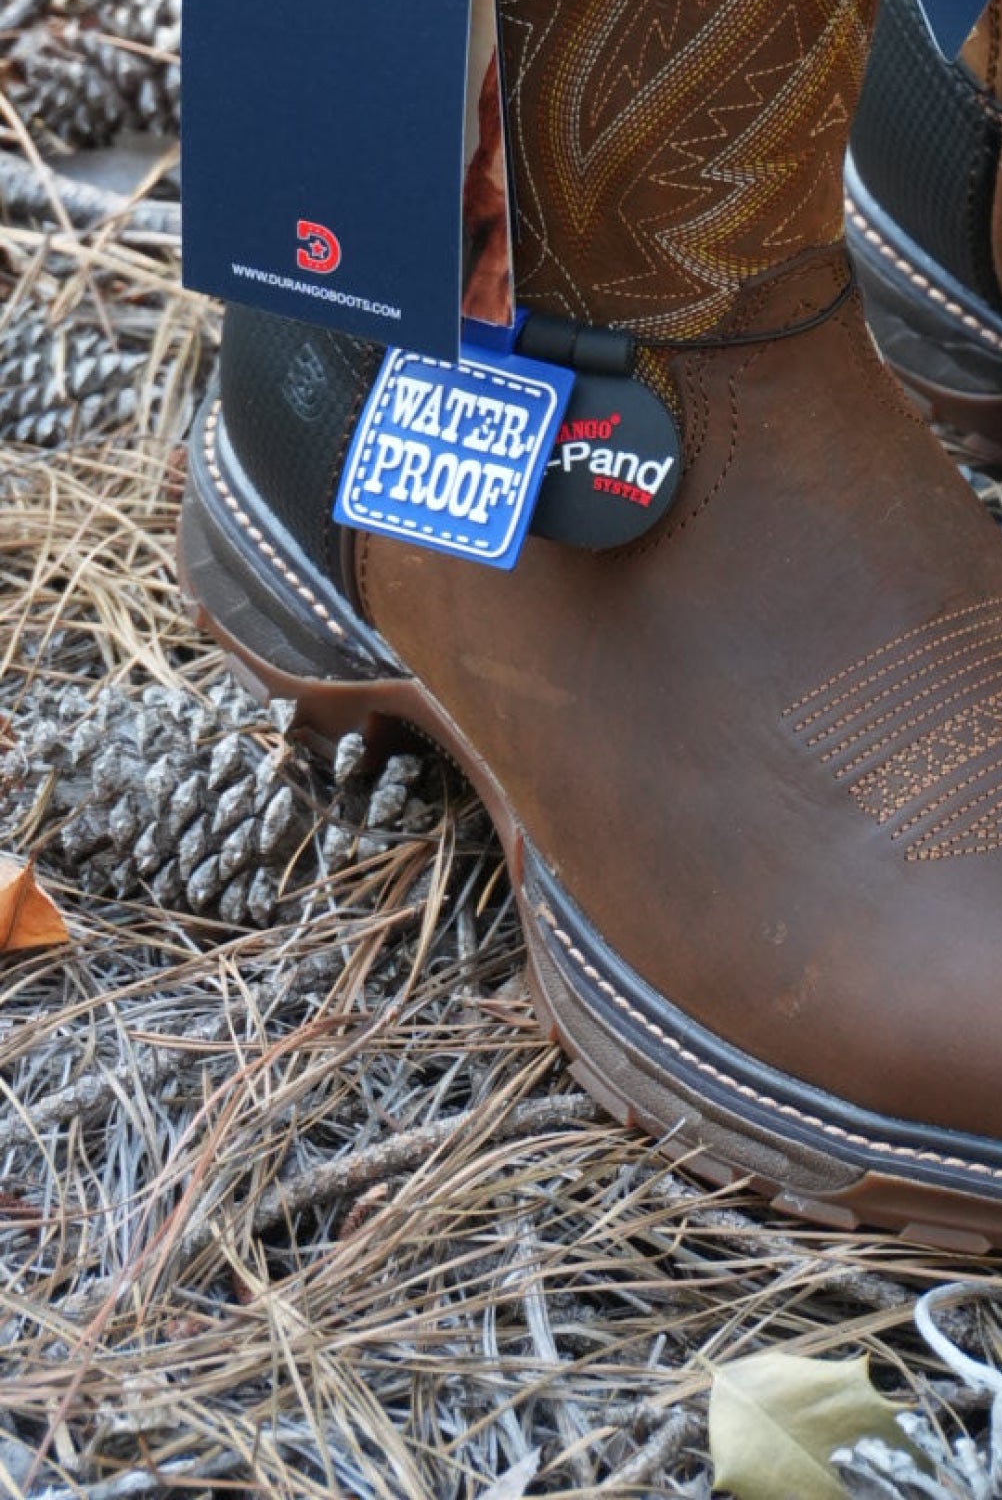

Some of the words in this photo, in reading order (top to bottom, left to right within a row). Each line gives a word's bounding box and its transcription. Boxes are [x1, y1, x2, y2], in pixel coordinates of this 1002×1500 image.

[231, 263, 402, 321] WWW.DURANGOBOOTS.COM
[391, 376, 531, 460] WATER
[557, 419, 613, 443] ANGO
[363, 434, 514, 525] PROOF
[546, 441, 675, 495] -Pand
[593, 475, 653, 508] SYSTEM
